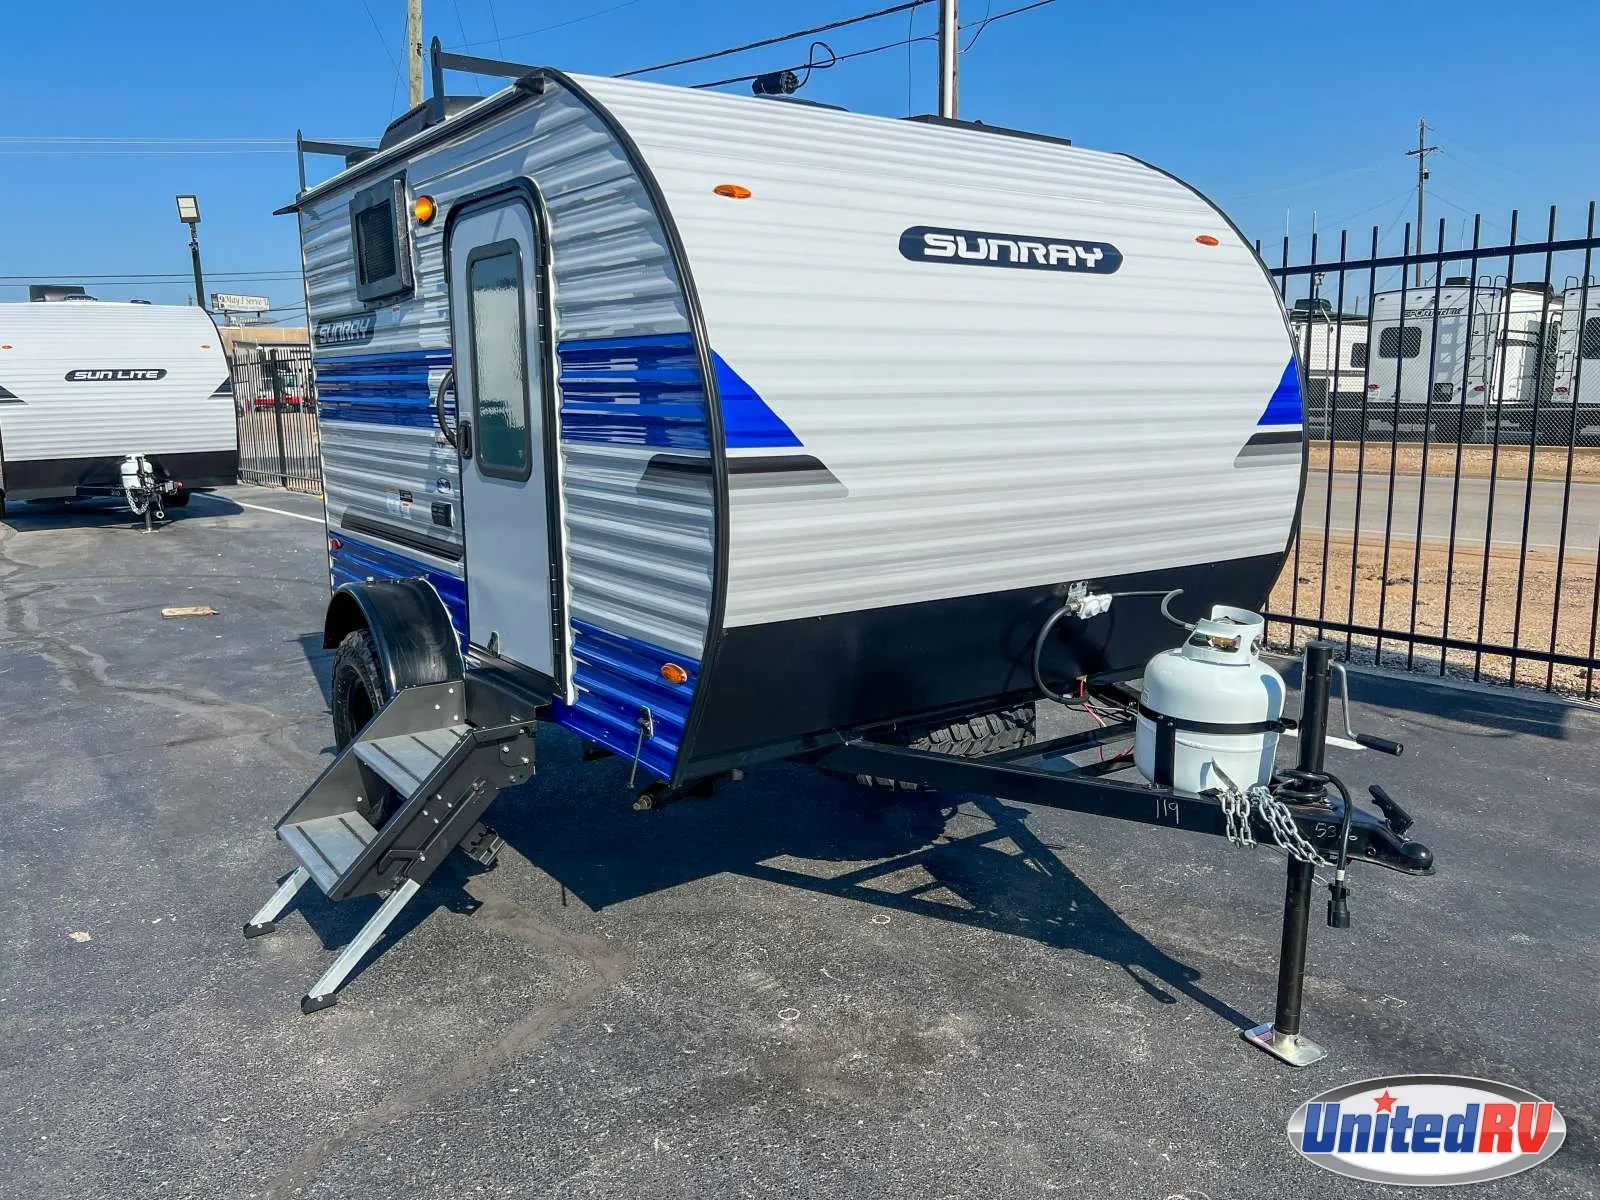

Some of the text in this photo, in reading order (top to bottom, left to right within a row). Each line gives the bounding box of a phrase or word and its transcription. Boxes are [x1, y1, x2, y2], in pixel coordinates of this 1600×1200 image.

[923, 232, 1104, 268] SUNRAY
[319, 318, 371, 344] SUNRAY
[73, 370, 160, 380] SUN LITE
